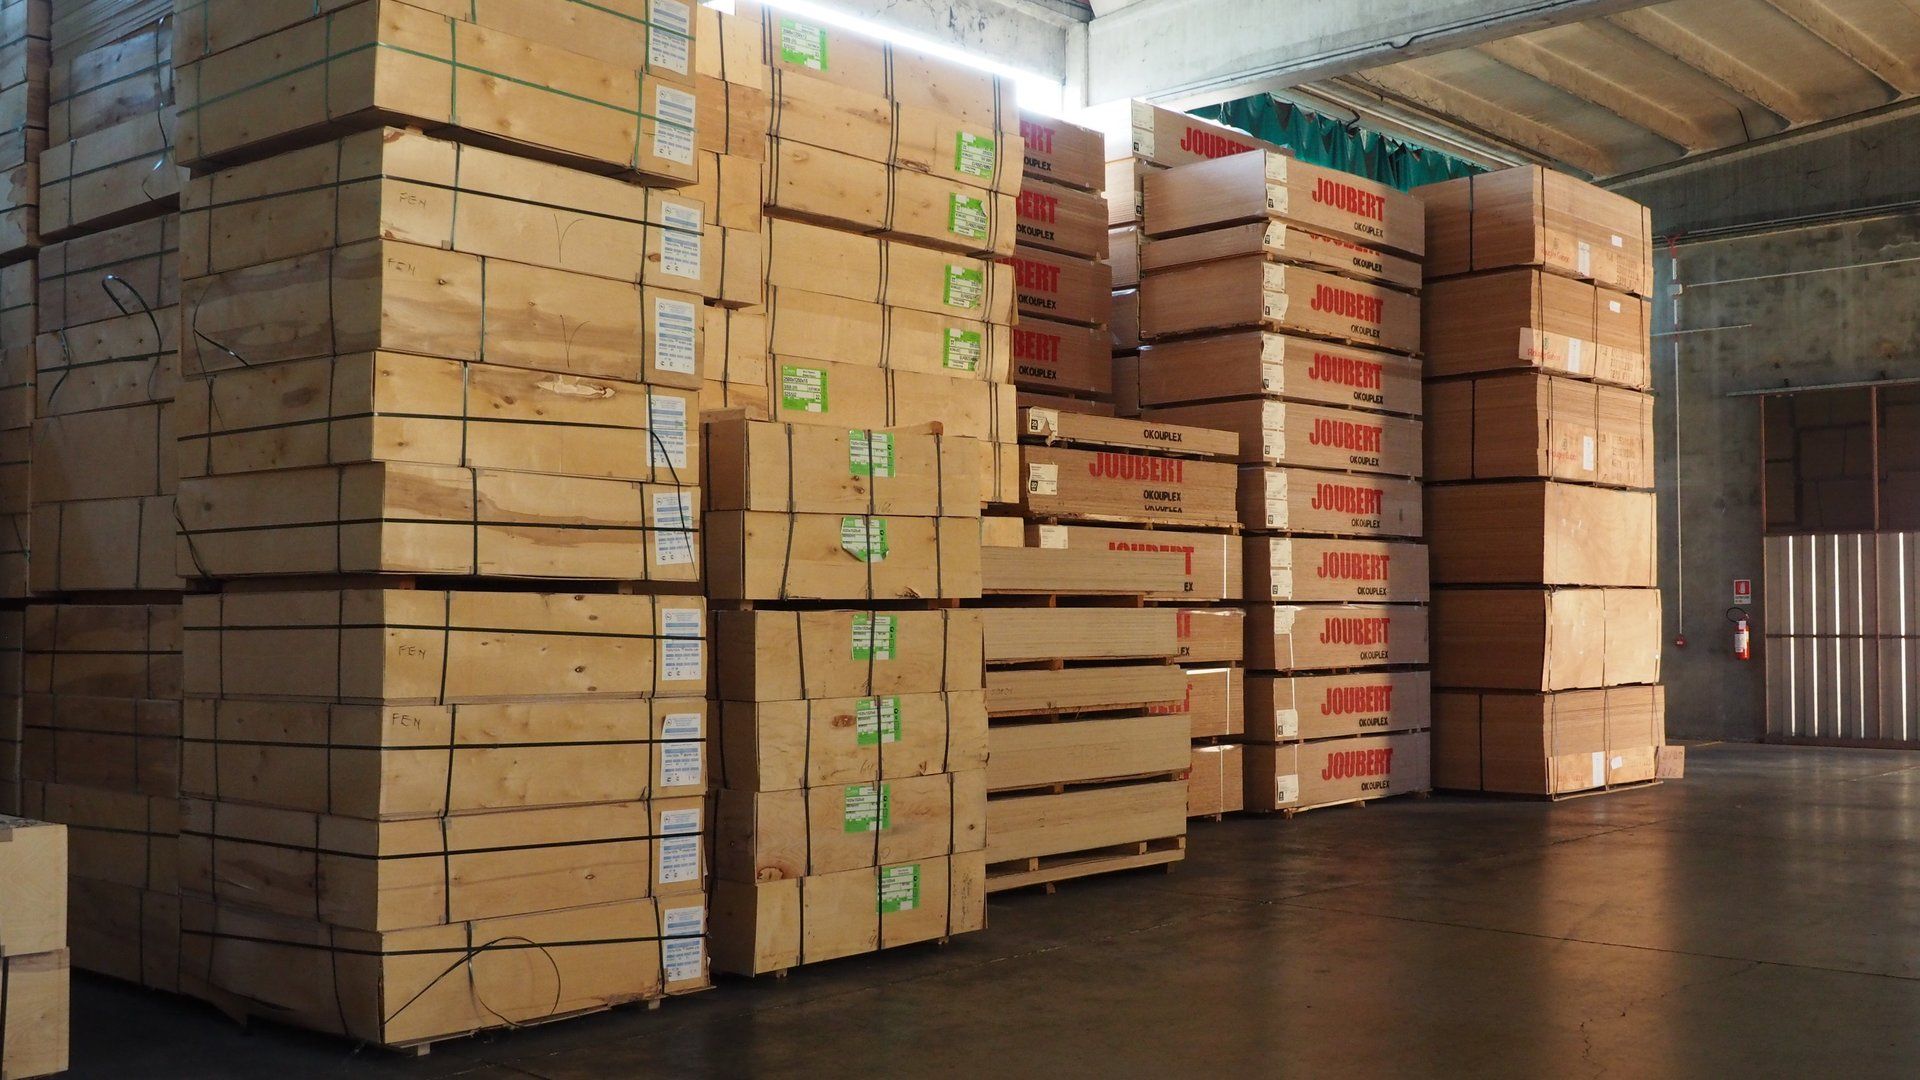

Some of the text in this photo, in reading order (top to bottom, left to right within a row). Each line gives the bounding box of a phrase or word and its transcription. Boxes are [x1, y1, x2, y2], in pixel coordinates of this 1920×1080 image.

[1181, 127, 1256, 159] JOUBE
[1312, 177, 1385, 222] JOUBERT
[1016, 223, 1055, 241] OKOUPLEX
[1353, 222, 1384, 238] OKOUPLEX
[1352, 257, 1383, 273] OKOUPLEX
[1018, 294, 1057, 310] OKOUPLEX
[1311, 284, 1384, 325] JOUBERT
[1351, 324, 1381, 339] OKOUPLEX
[1018, 365, 1057, 380] OKOUPLEX
[1308, 352, 1383, 390] JOUBERT
[1353, 391, 1384, 405] OKOUPLEX
[1143, 429, 1182, 443] OKOUPLEX
[1309, 418, 1383, 453] JOUBERT
[1350, 455, 1380, 467] OKOUPLEX
[1143, 489, 1182, 502] OKOUPLEX
[1311, 483, 1384, 515] JOUBERT
[1351, 518, 1381, 529] OKOUPLEX
[1317, 552, 1391, 581] JOUBERT
[1357, 586, 1388, 596] OKOUPLEX
[1319, 617, 1391, 646] JOUBERT
[1360, 650, 1389, 661] OKOUPLEX
[1320, 685, 1393, 716] JOUBERT
[1358, 716, 1389, 728] OKOUPLEX
[1321, 747, 1394, 782] JOUBERT
[1360, 780, 1390, 792] OKOUPLEX
